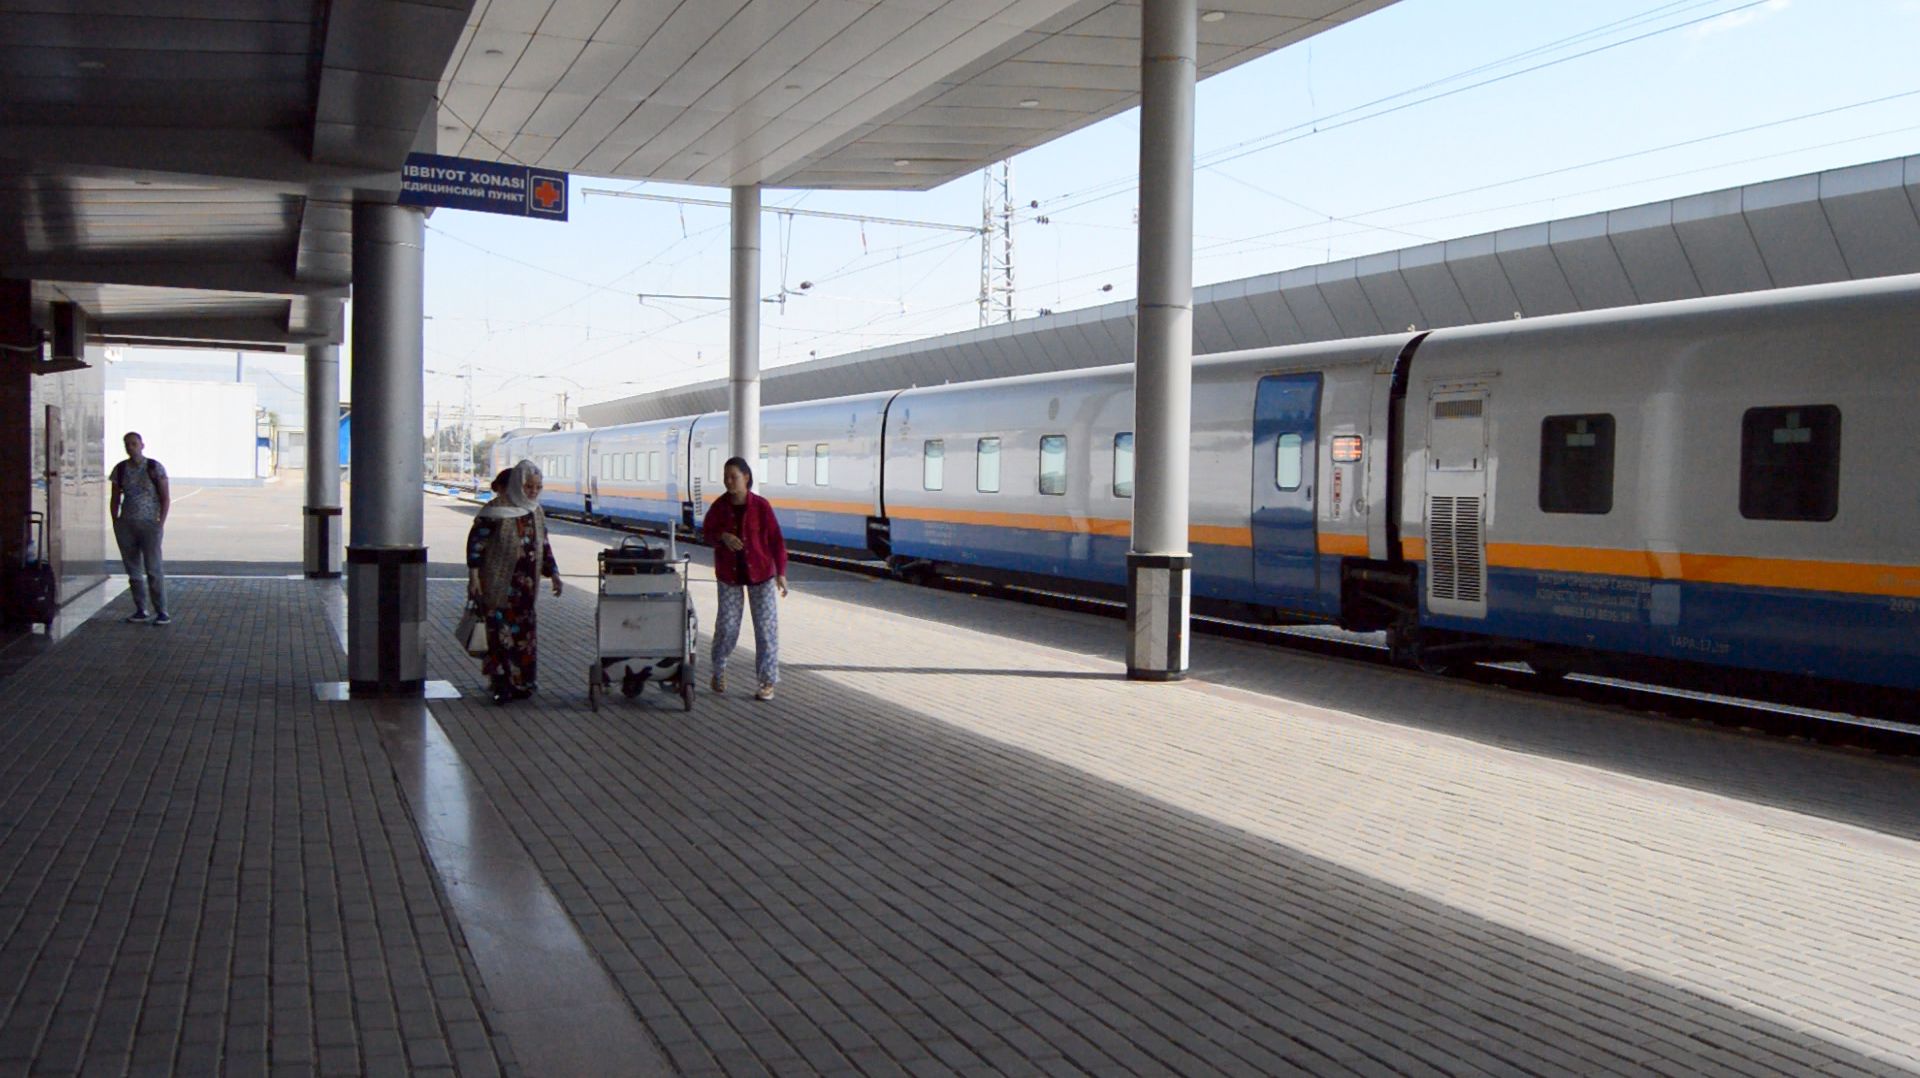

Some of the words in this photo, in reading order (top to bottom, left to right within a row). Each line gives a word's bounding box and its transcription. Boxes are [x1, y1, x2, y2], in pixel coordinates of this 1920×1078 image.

[403, 164, 467, 182] IBBIYOT
[470, 172, 525, 189] XONASI
[487, 191, 525, 202] ПУНКТ
